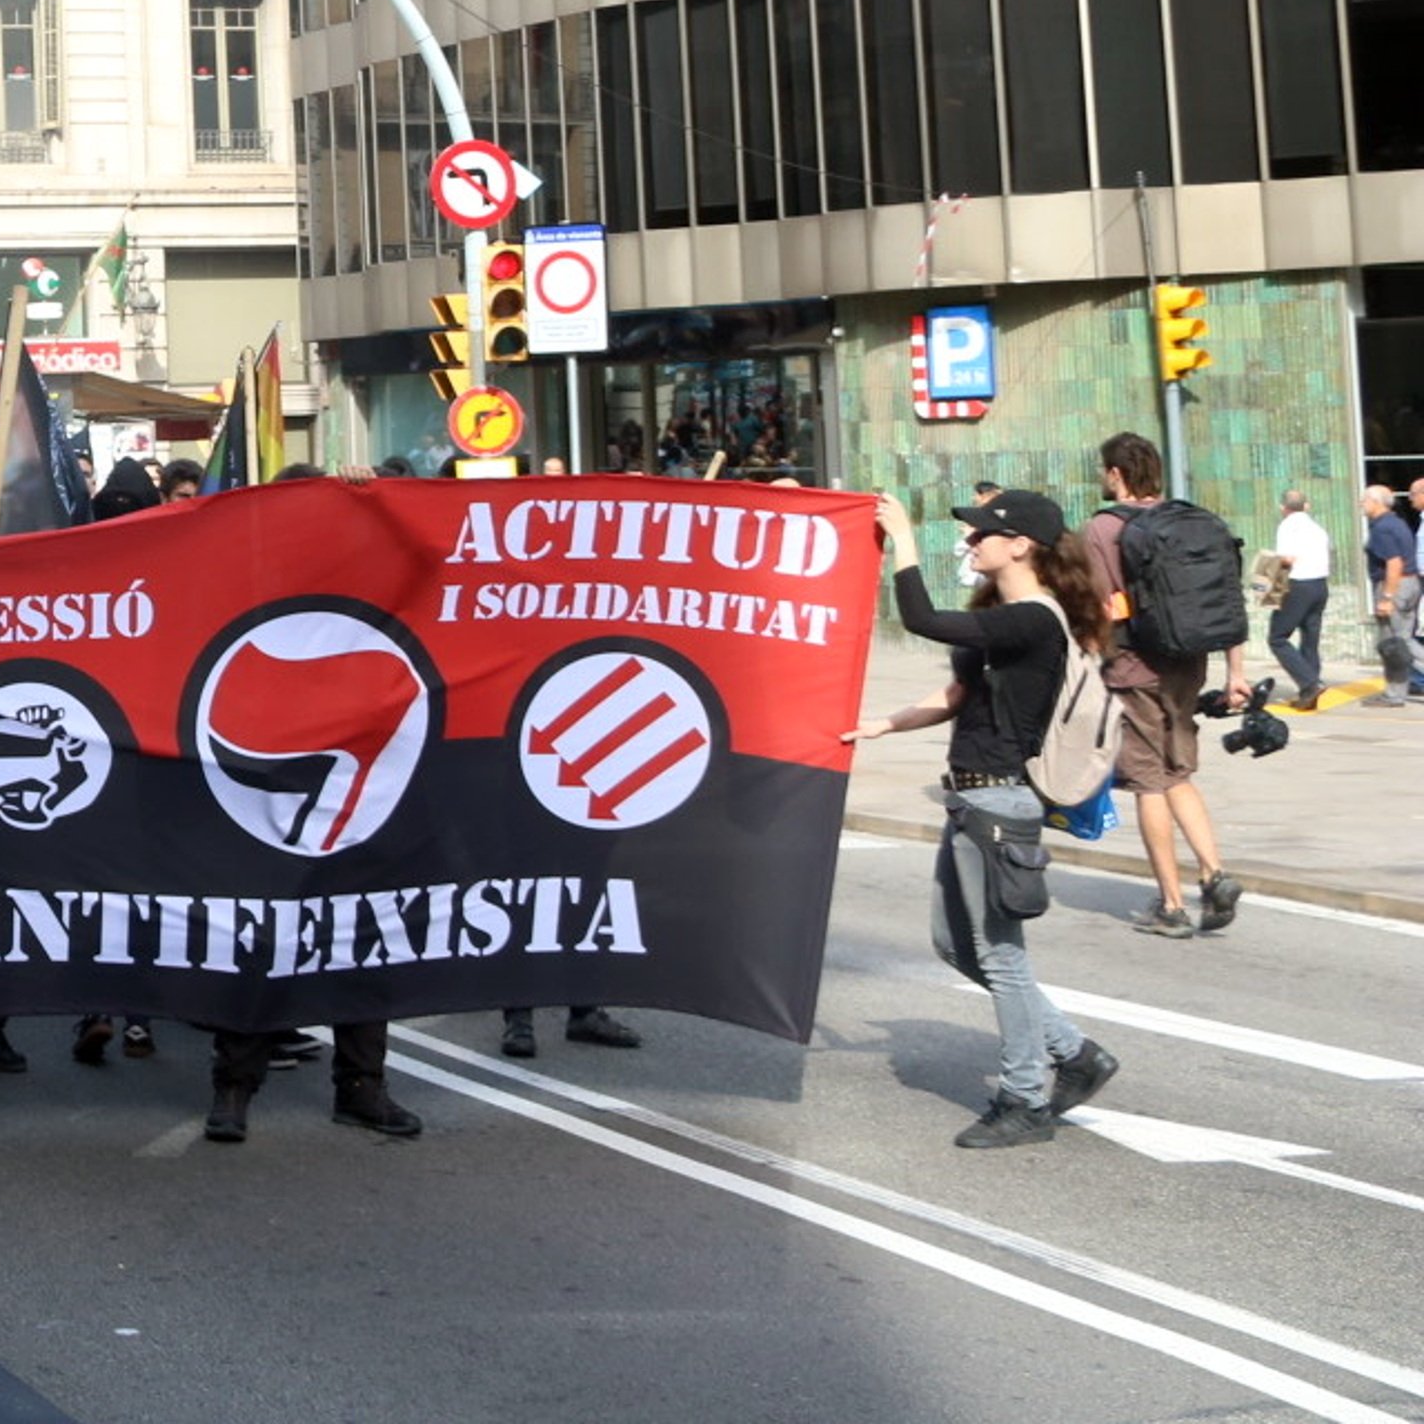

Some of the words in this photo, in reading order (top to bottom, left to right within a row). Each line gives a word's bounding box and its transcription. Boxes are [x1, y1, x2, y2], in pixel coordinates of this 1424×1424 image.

[933, 317, 985, 388] P
[445, 499, 840, 577] ACTITUD
[438, 584, 463, 623] I
[473, 582, 838, 645] SOLIDARITAT
